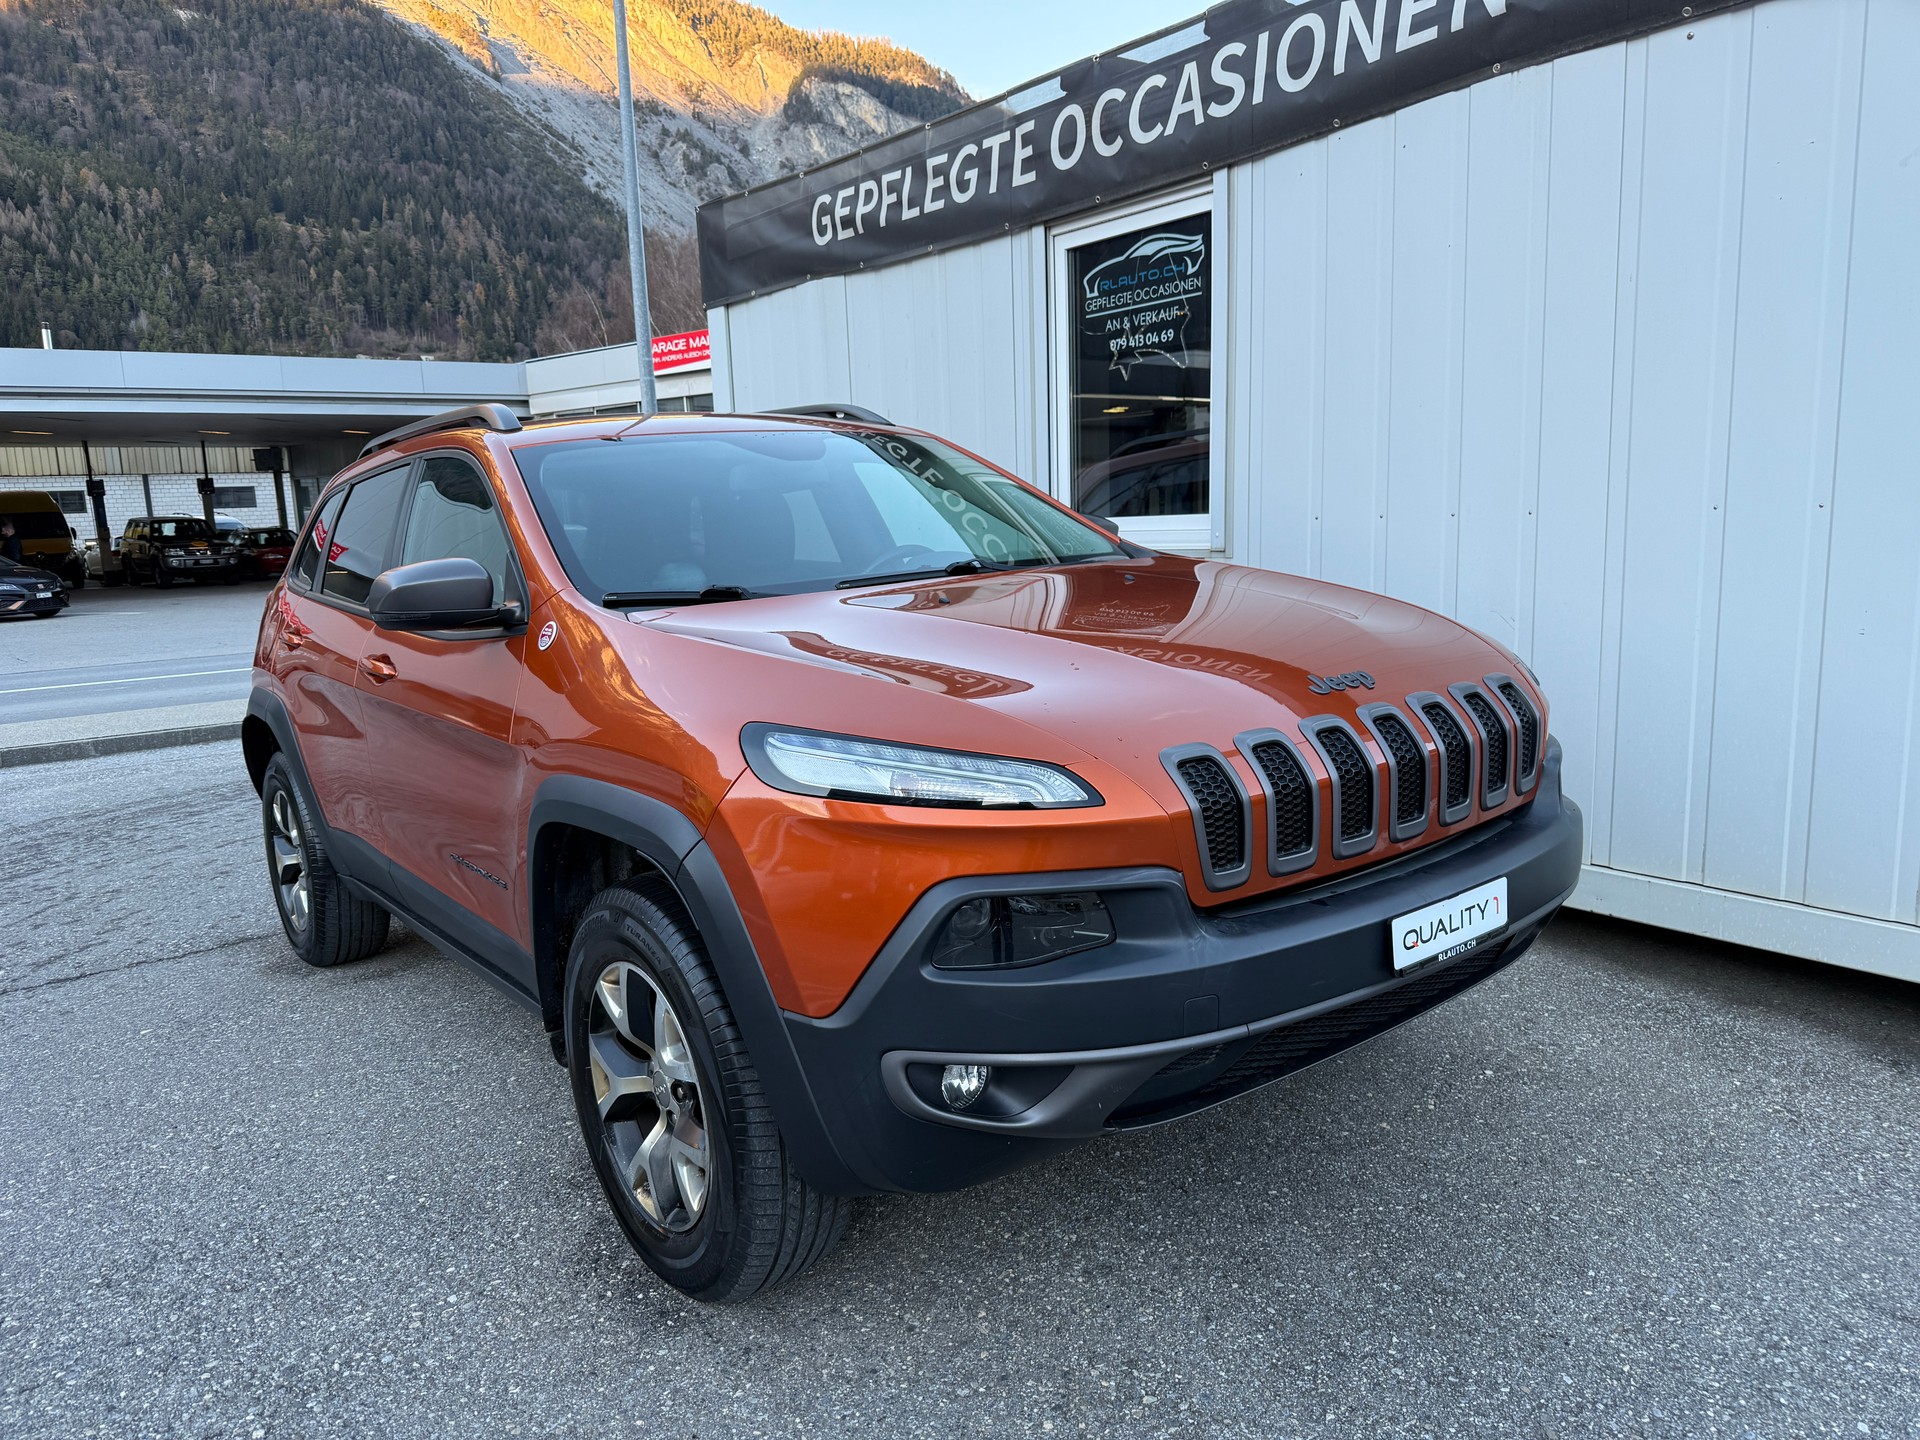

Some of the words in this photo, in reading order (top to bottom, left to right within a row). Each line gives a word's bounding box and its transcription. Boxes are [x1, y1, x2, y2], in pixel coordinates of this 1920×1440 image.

[811, 119, 1036, 247] GEPFLEGTE
[1100, 262, 1185, 291] RLAUTO.CH
[1085, 291, 1133, 312] GEPFLEGTE
[1134, 276, 1201, 301] OCCASIONEN
[1105, 317, 1121, 332] AN
[1122, 316, 1131, 330] &
[1133, 306, 1179, 327] VERKAUF
[652, 339, 687, 354] ARAGE
[1109, 336, 1127, 351] 079
[1128, 334, 1144, 348] 413
[1146, 332, 1159, 345] 04
[1160, 328, 1174, 342] 69
[1307, 670, 1376, 695] Jeep
[625, 923, 665, 966] TURANZA
[1438, 939, 1477, 962] RLAUTO.CH
